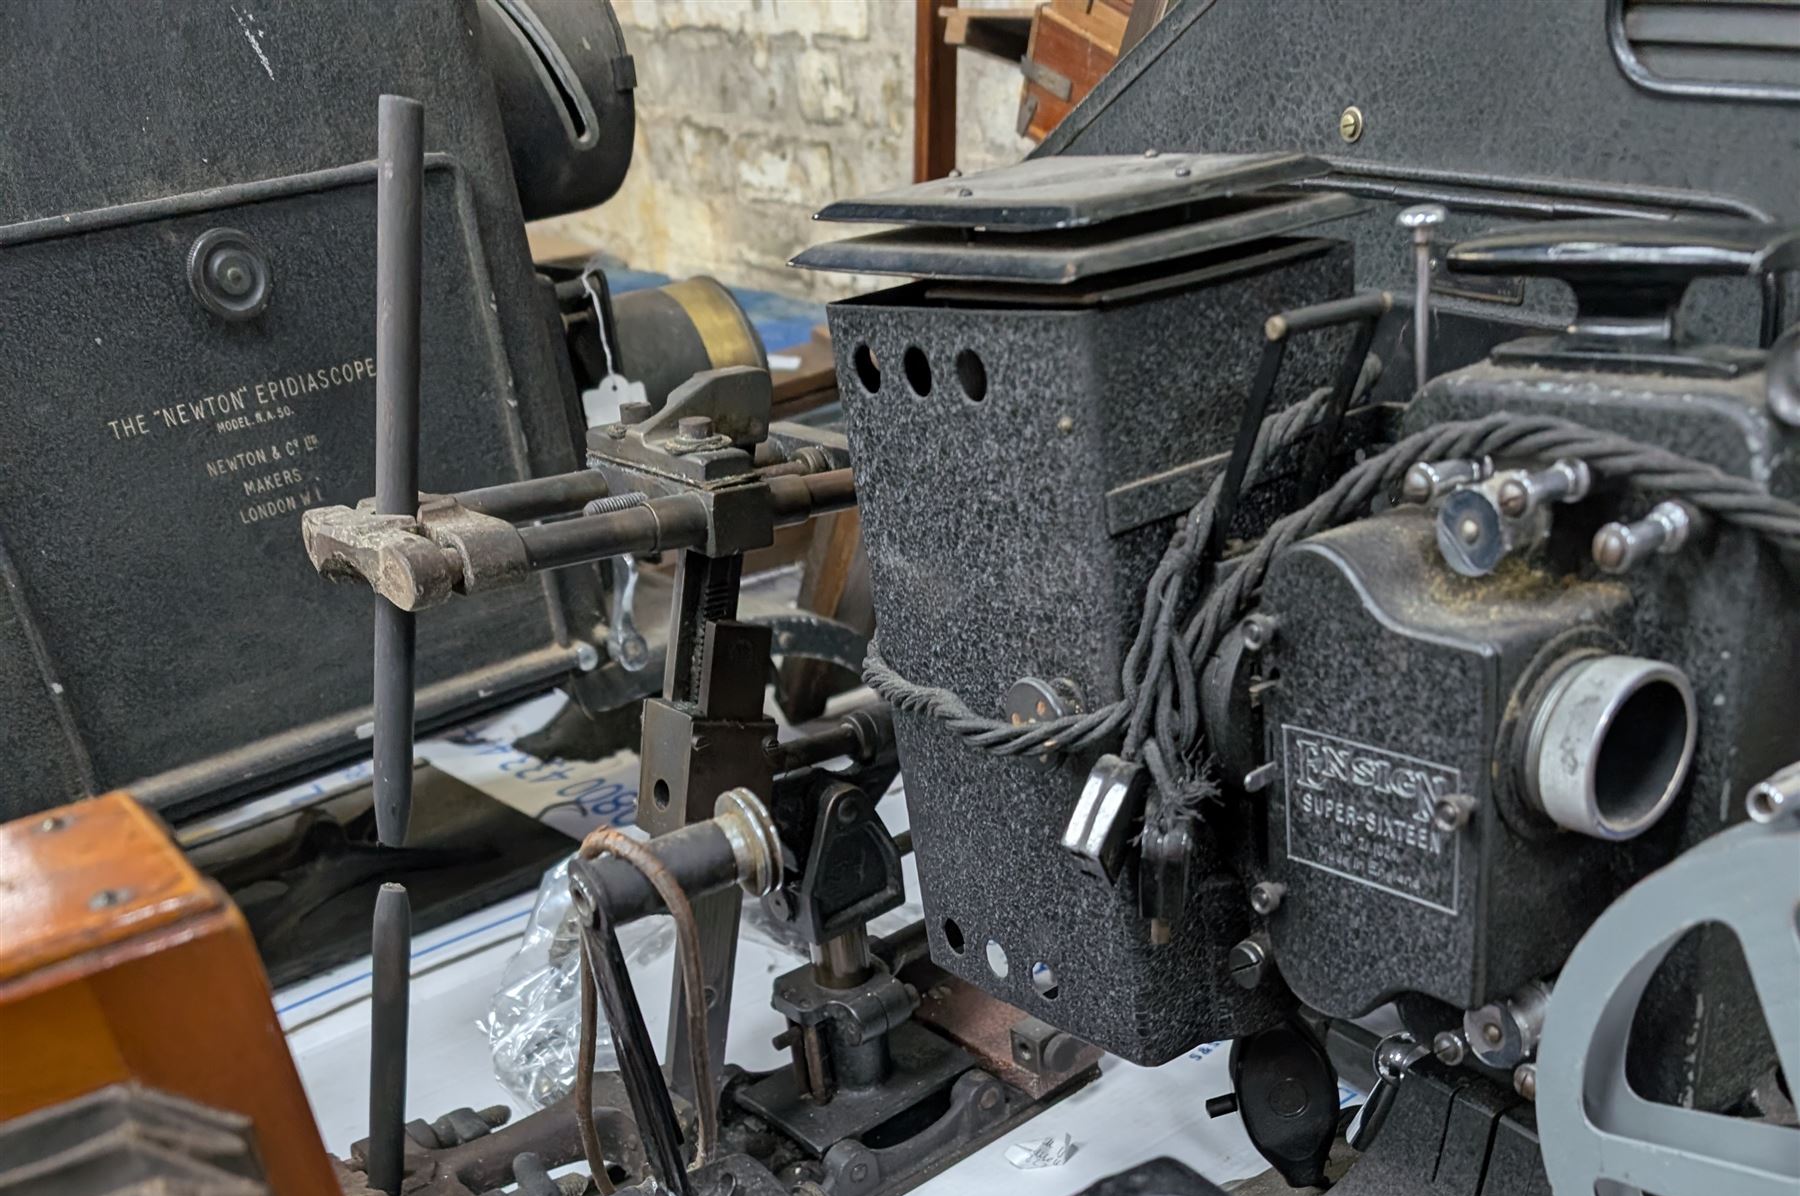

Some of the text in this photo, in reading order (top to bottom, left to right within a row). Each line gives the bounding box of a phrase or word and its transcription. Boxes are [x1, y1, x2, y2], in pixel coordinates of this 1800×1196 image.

[108, 414, 150, 440] THE
[255, 358, 376, 404] EPIDIASCOPE
[206, 448, 267, 478] NEWTON
[271, 445, 282, 460] &
[243, 468, 302, 497] MAKERS
[240, 496, 296, 524] LONDON
[1297, 739, 1446, 823] ENSIGN
[1303, 793, 1440, 855] SUPER-SIXTEEN
